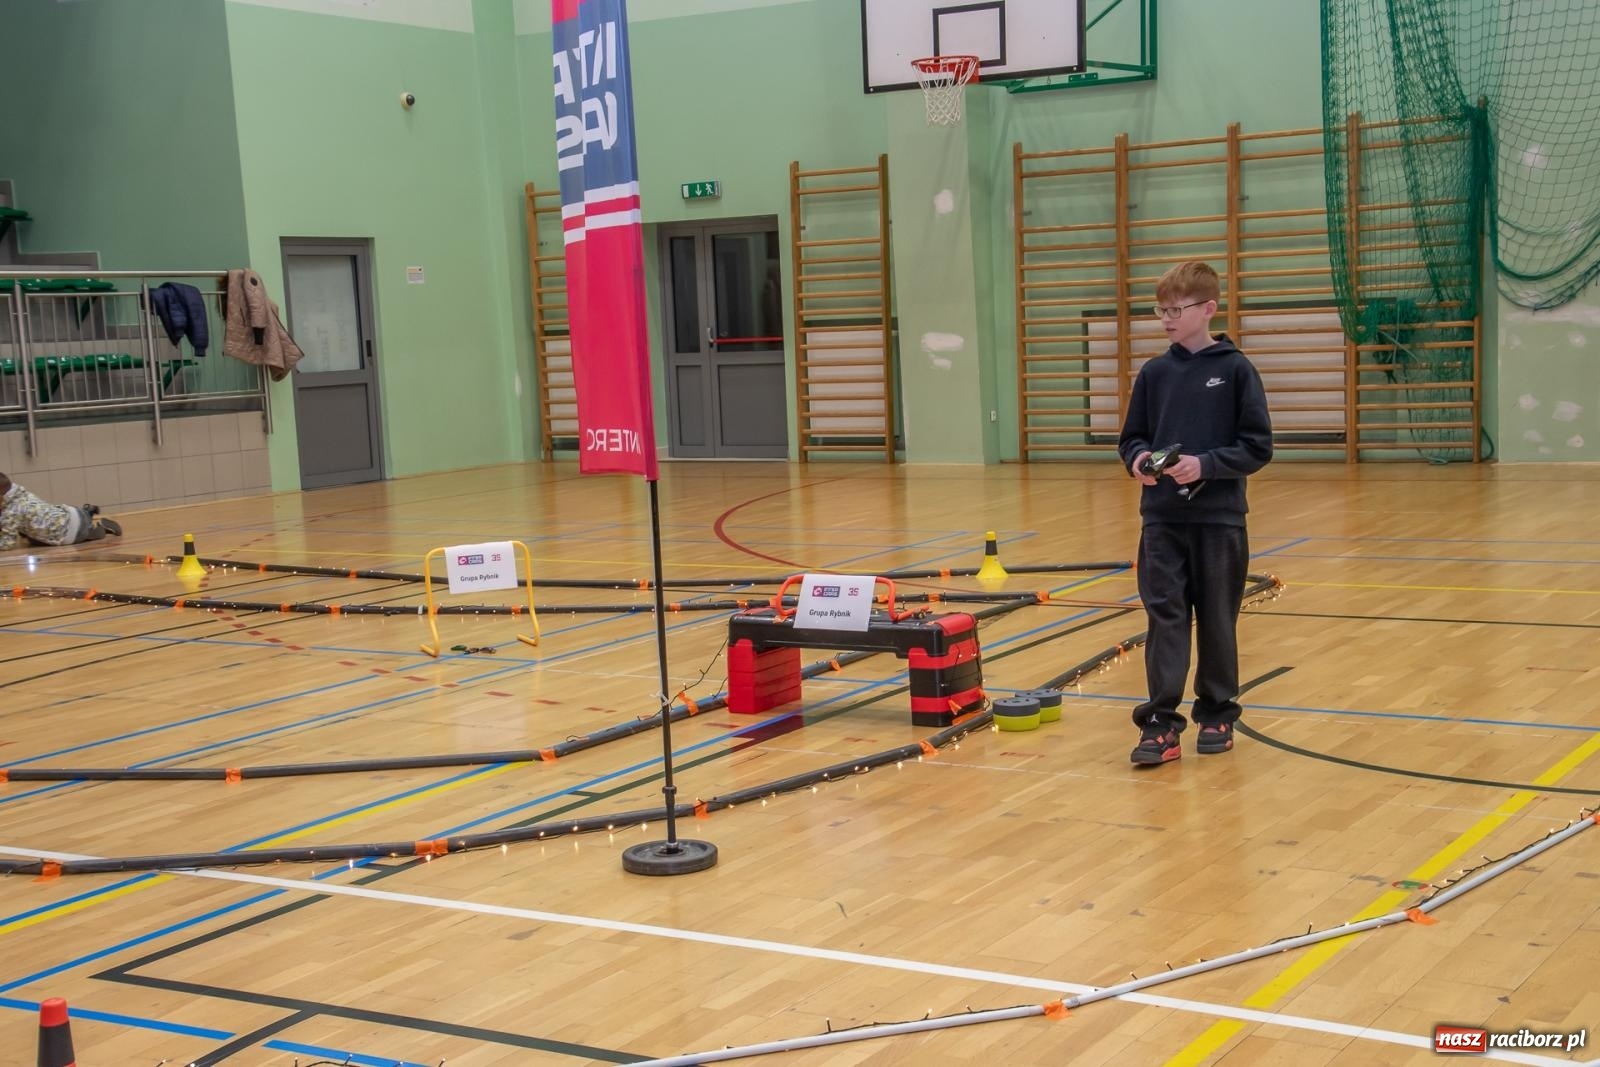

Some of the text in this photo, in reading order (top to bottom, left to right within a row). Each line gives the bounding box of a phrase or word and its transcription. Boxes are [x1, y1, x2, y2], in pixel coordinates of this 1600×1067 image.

[479, 573, 499, 581] Rybnik
[809, 609, 851, 618] Grupa Rybnik
